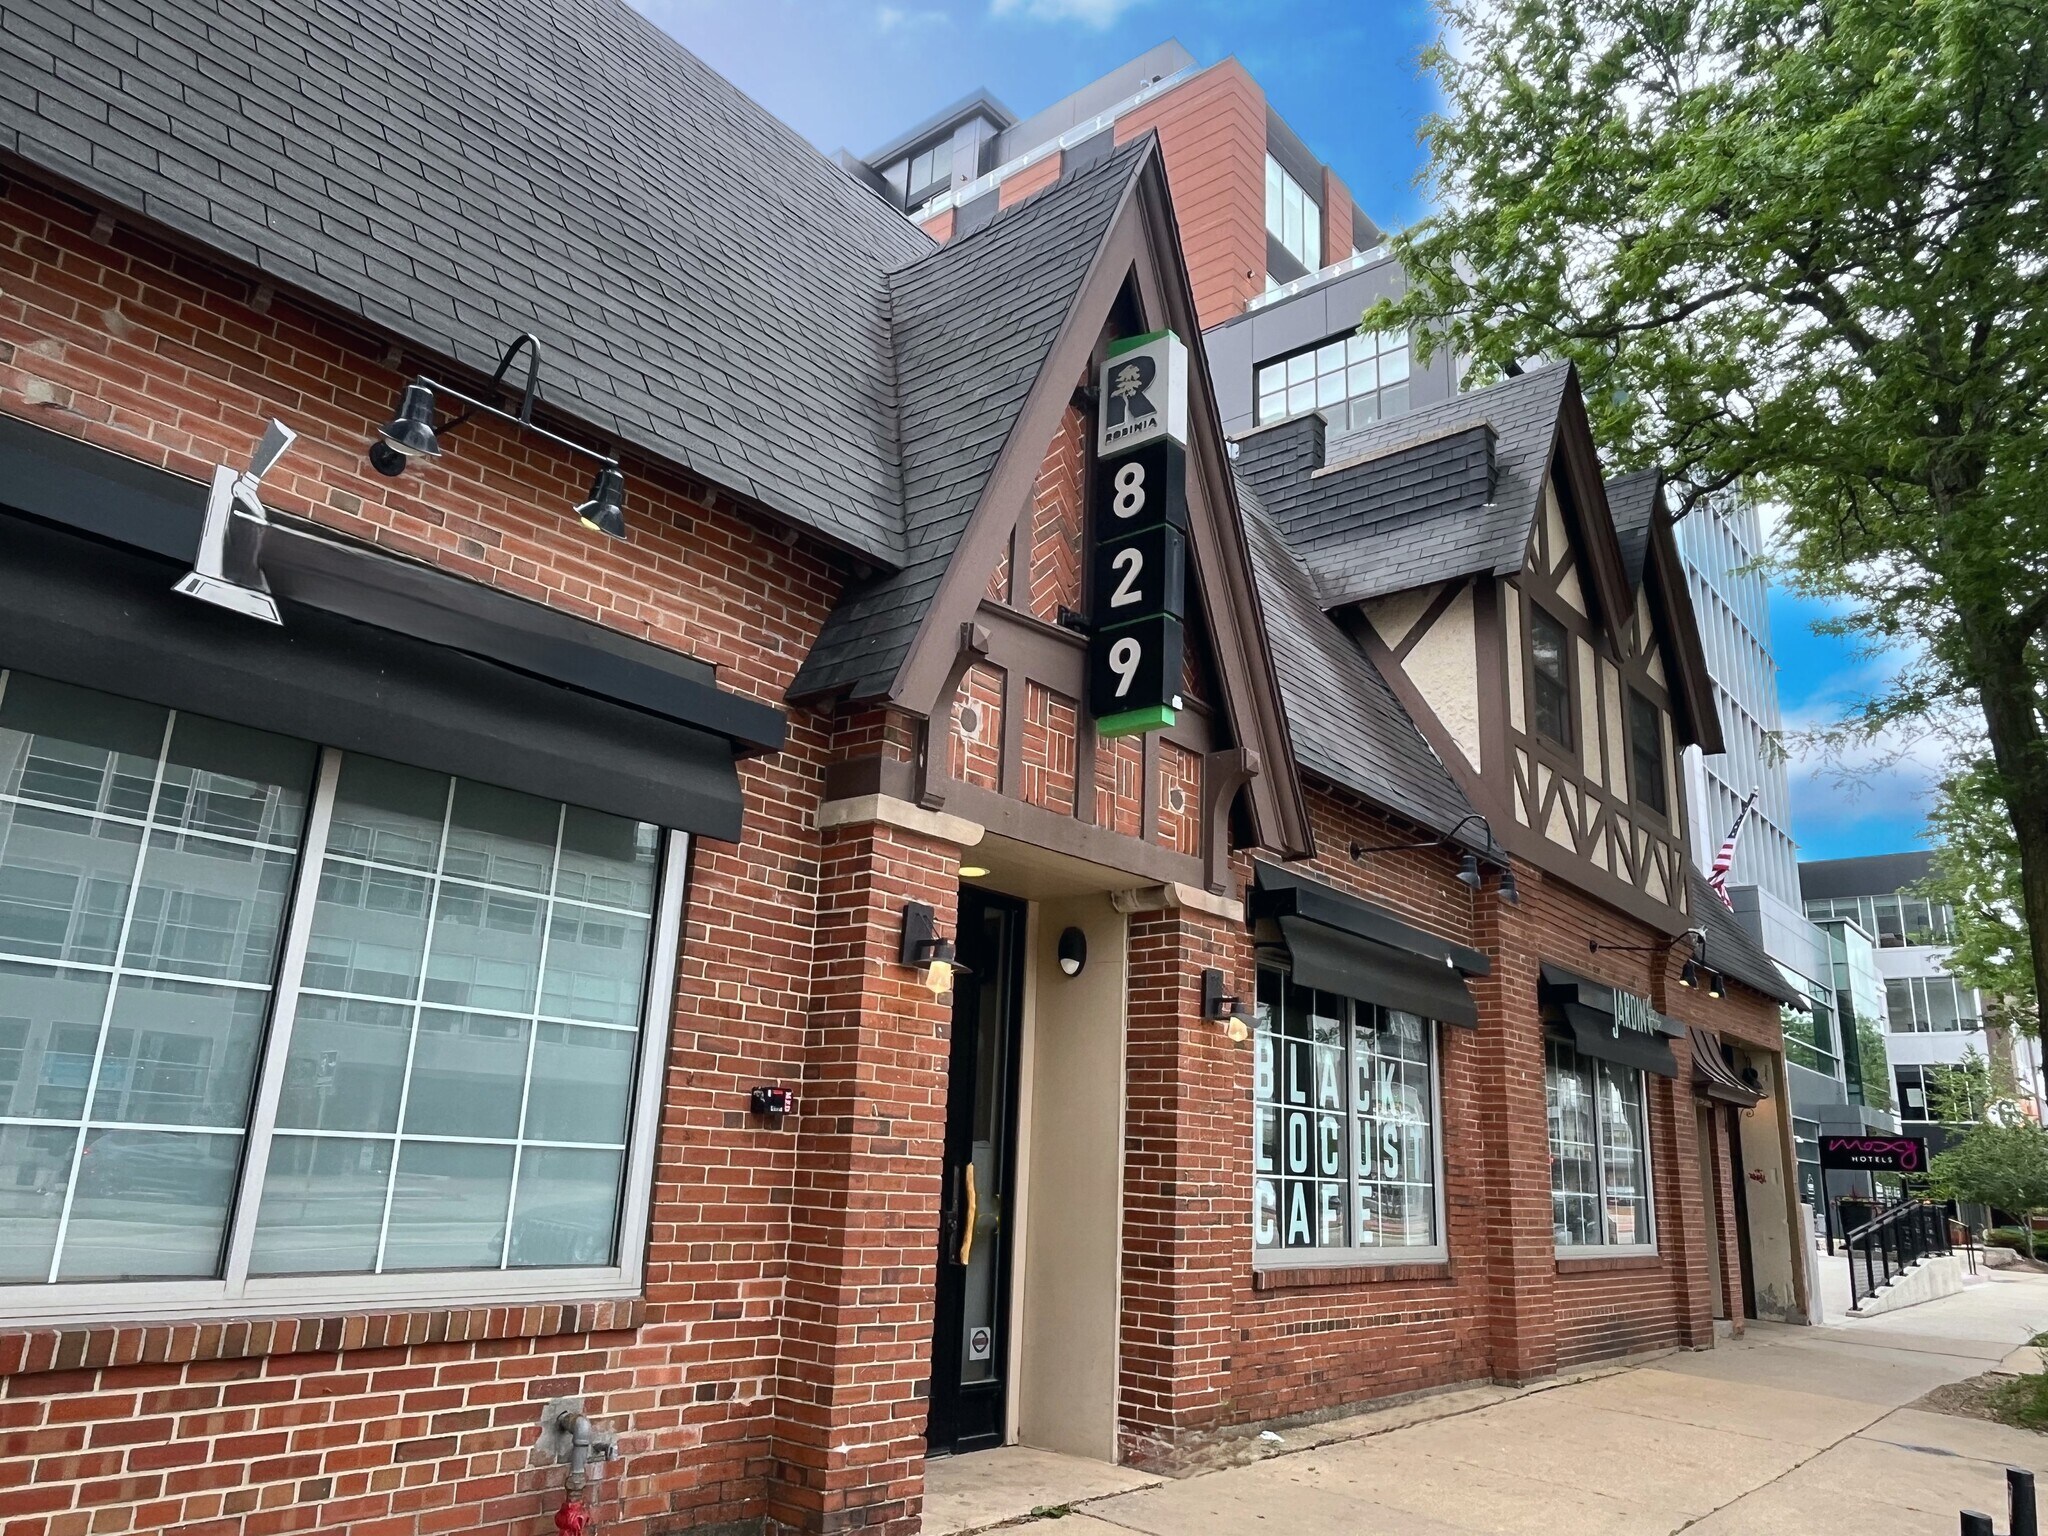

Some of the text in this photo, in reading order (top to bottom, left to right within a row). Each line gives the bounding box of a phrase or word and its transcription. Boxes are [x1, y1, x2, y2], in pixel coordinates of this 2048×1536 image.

[1106, 355, 1157, 430] R
[1105, 418, 1157, 444] ROBINIA
[1257, 1036, 1396, 1115] BLACK
[1256, 1108, 1423, 1180] LOCUST
[1256, 1180, 1374, 1245] CAFE
